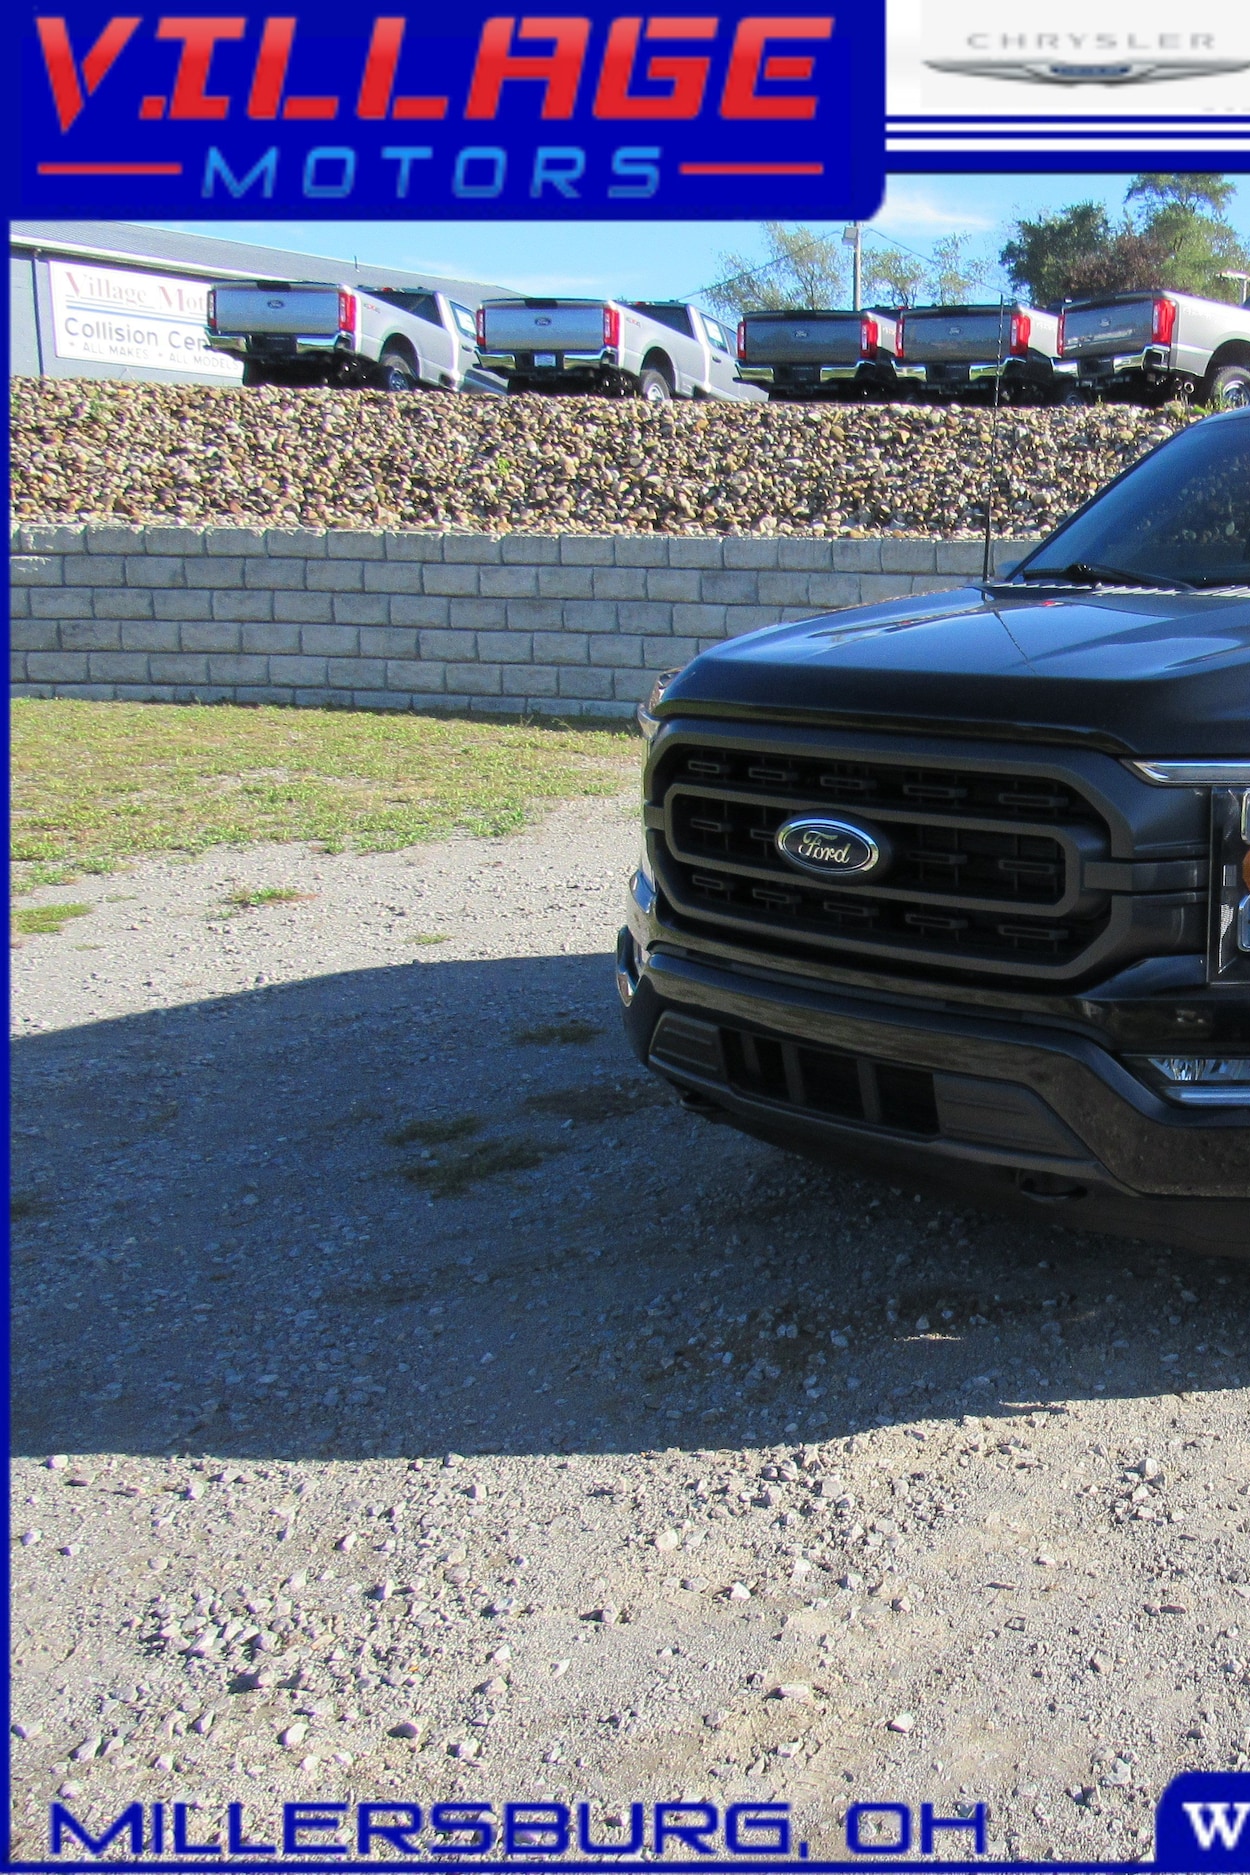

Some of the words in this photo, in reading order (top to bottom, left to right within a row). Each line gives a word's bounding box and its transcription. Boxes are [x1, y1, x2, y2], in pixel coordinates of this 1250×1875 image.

[65, 271, 147, 306] Village
[65, 317, 158, 346] Collision
[83, 341, 104, 355] ALL
[109, 345, 149, 360] MAKES
[169, 353, 189, 365] ALL
[193, 355, 239, 370] MODELS
[799, 830, 851, 864] Ford
